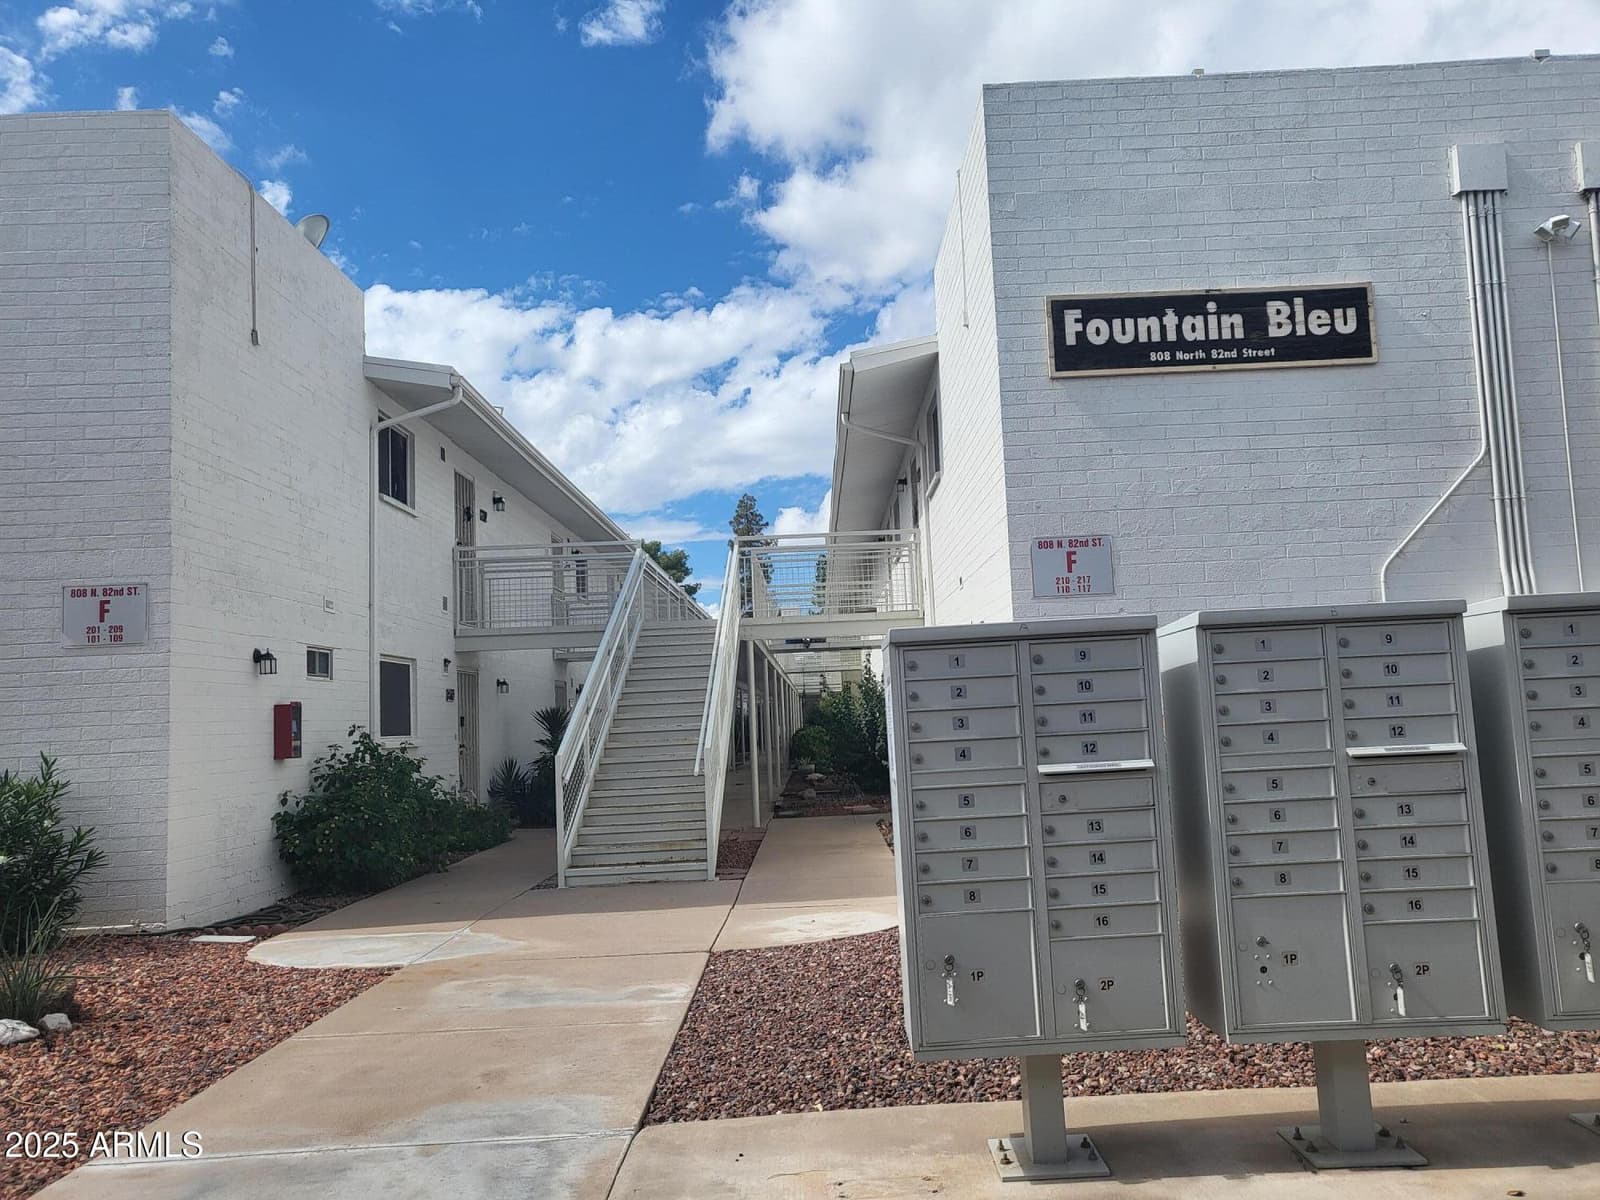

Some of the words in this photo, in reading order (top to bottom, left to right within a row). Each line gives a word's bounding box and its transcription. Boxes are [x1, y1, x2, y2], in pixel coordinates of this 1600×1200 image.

[1063, 301, 1245, 346] Fountain
[1266, 297, 1358, 338] Bleu
[1150, 351, 1171, 362] 808
[1176, 349, 1207, 360] North
[1211, 347, 1238, 359] 82nd
[1242, 346, 1276, 358] Street
[1038, 540, 1054, 550] 808
[1068, 538, 1089, 549] 82nd
[1091, 538, 1105, 547] ST.
[1066, 550, 1077, 573] F
[1055, 577, 1070, 585] 210
[1077, 575, 1091, 585] 217
[70, 588, 88, 598] 808
[102, 587, 124, 597] 82nd
[126, 586, 141, 596] ST.
[1056, 585, 1070, 594] 110
[1077, 584, 1091, 593] 117
[99, 599, 111, 623] F
[86, 626, 101, 635] 201
[108, 624, 124, 634] 209
[1568, 623, 1574, 634] 1
[87, 635, 101, 643] 101
[109, 634, 124, 643] 109
[1260, 639, 1266, 648] 1
[1385, 633, 1393, 644] 9
[1079, 650, 1087, 661] 9
[1571, 655, 1579, 665] 2
[953, 657, 960, 666] 1
[1385, 664, 1398, 674] 10
[1262, 670, 1270, 681] 2
[1079, 680, 1091, 691] 10
[1575, 685, 1582, 696] 3
[956, 687, 963, 697] 2
[1388, 695, 1400, 705] 11
[1265, 701, 1272, 712] 3
[1082, 712, 1093, 722] 11
[1578, 717, 1586, 727] 4
[957, 718, 965, 729] 3
[1267, 732, 1274, 742] 4
[1391, 726, 1404, 737] 12
[1083, 743, 1097, 753] 12
[959, 749, 966, 759] 4
[1583, 763, 1592, 774] 5
[1271, 778, 1279, 789] 5
[963, 795, 970, 806] 5
[1587, 795, 1595, 806] 6
[1274, 810, 1281, 820] 6
[1398, 804, 1412, 815] 13
[1088, 821, 1102, 832] 13
[964, 827, 972, 838] 6
[1591, 827, 1598, 838] 7
[1276, 841, 1284, 852] 7
[1402, 835, 1415, 847] 14
[1092, 852, 1104, 863] 14
[966, 859, 974, 869] 7
[1279, 872, 1287, 884] 8
[1405, 867, 1419, 878] 15
[1093, 884, 1106, 895] 15
[968, 890, 976, 901] 8
[1408, 899, 1422, 911] 16
[1095, 915, 1109, 926] 16
[1283, 953, 1297, 964] 1P
[1415, 964, 1430, 976] 2P
[970, 971, 984, 982] 1P
[1100, 979, 1114, 991] 2P
